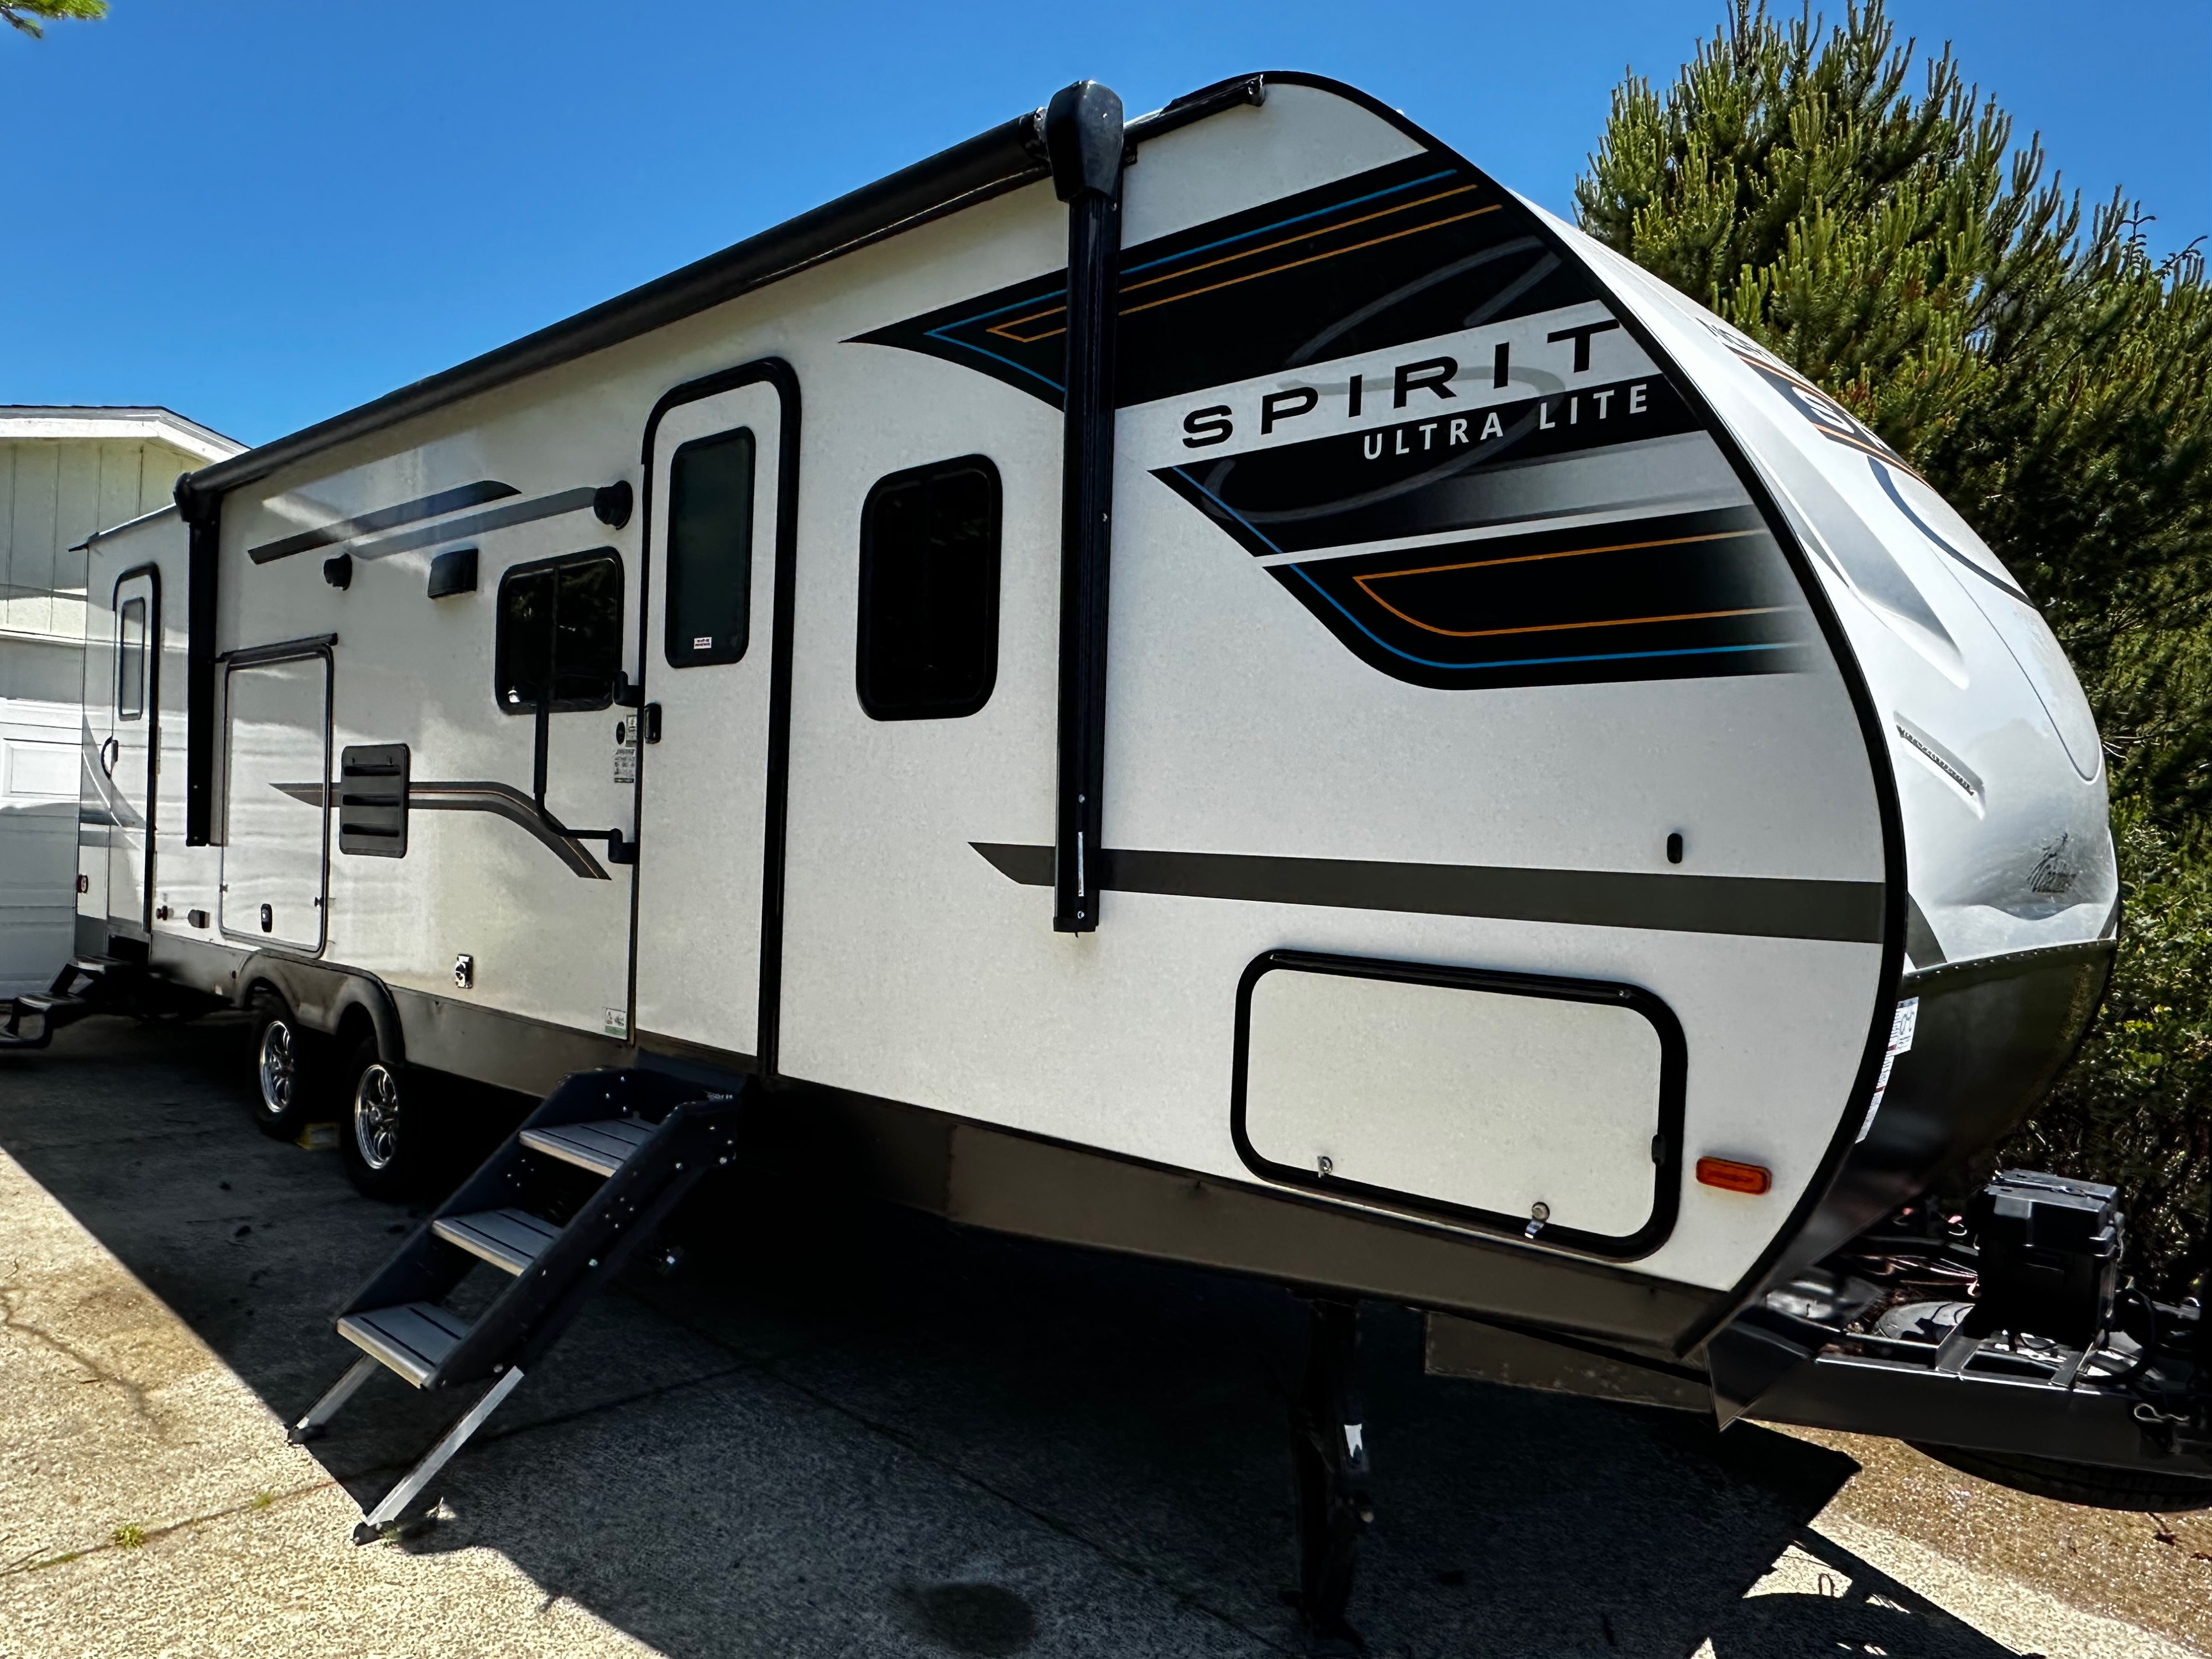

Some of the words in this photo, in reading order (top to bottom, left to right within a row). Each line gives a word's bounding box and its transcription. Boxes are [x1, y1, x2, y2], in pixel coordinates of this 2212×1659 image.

[1182, 319, 1620, 448] SPIRIT
[1363, 412, 1504, 460] ULTRA
[1539, 383, 1648, 430] LITE
